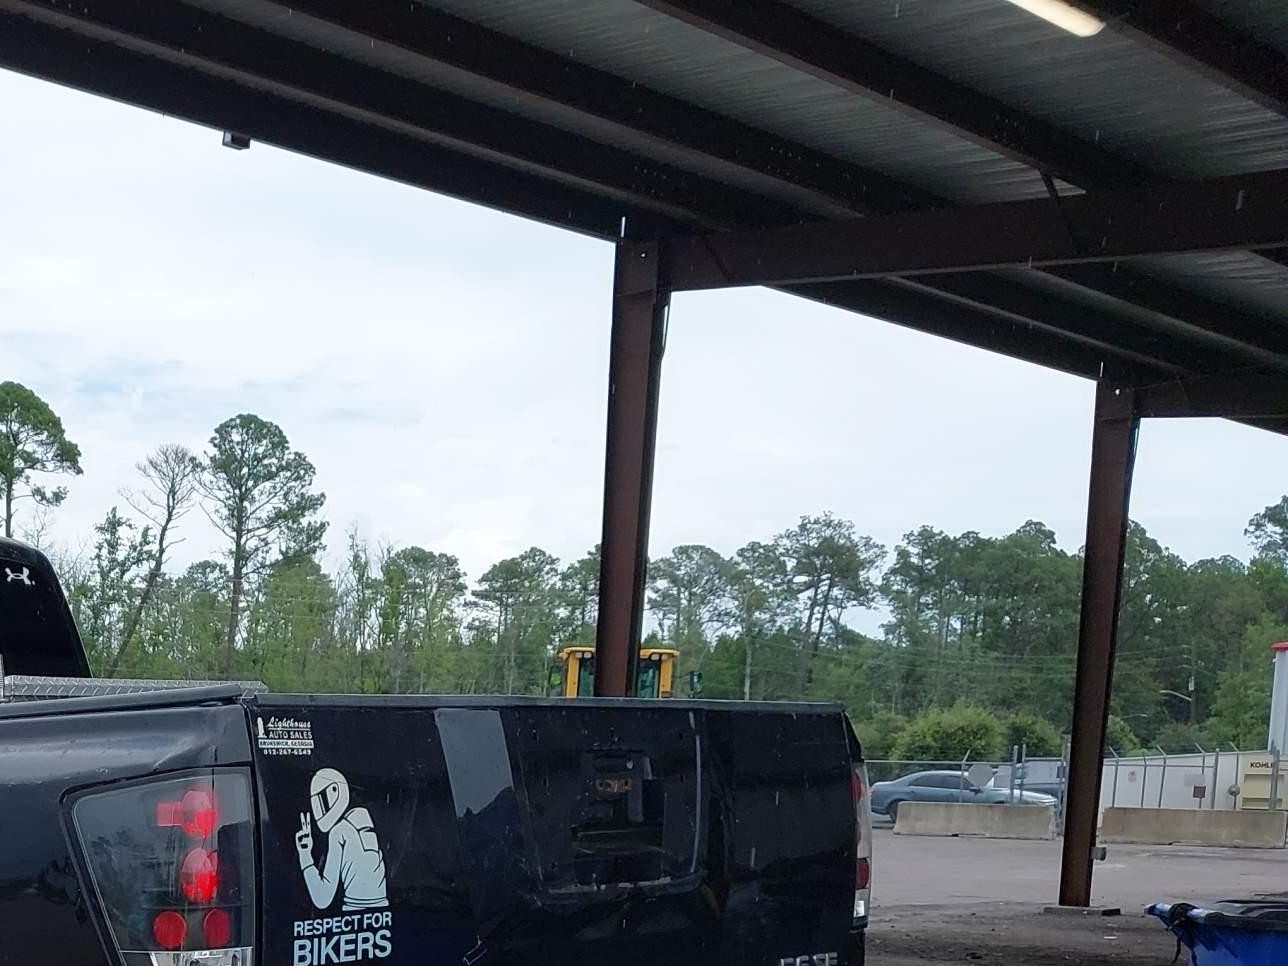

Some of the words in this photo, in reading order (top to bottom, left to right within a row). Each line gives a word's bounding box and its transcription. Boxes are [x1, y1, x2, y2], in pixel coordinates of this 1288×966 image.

[266, 716, 311, 729] Lighthouse
[269, 731, 289, 739] AUTO
[290, 731, 313, 740] SALES
[293, 915, 362, 937] RESPECT
[363, 911, 392, 929] FOR
